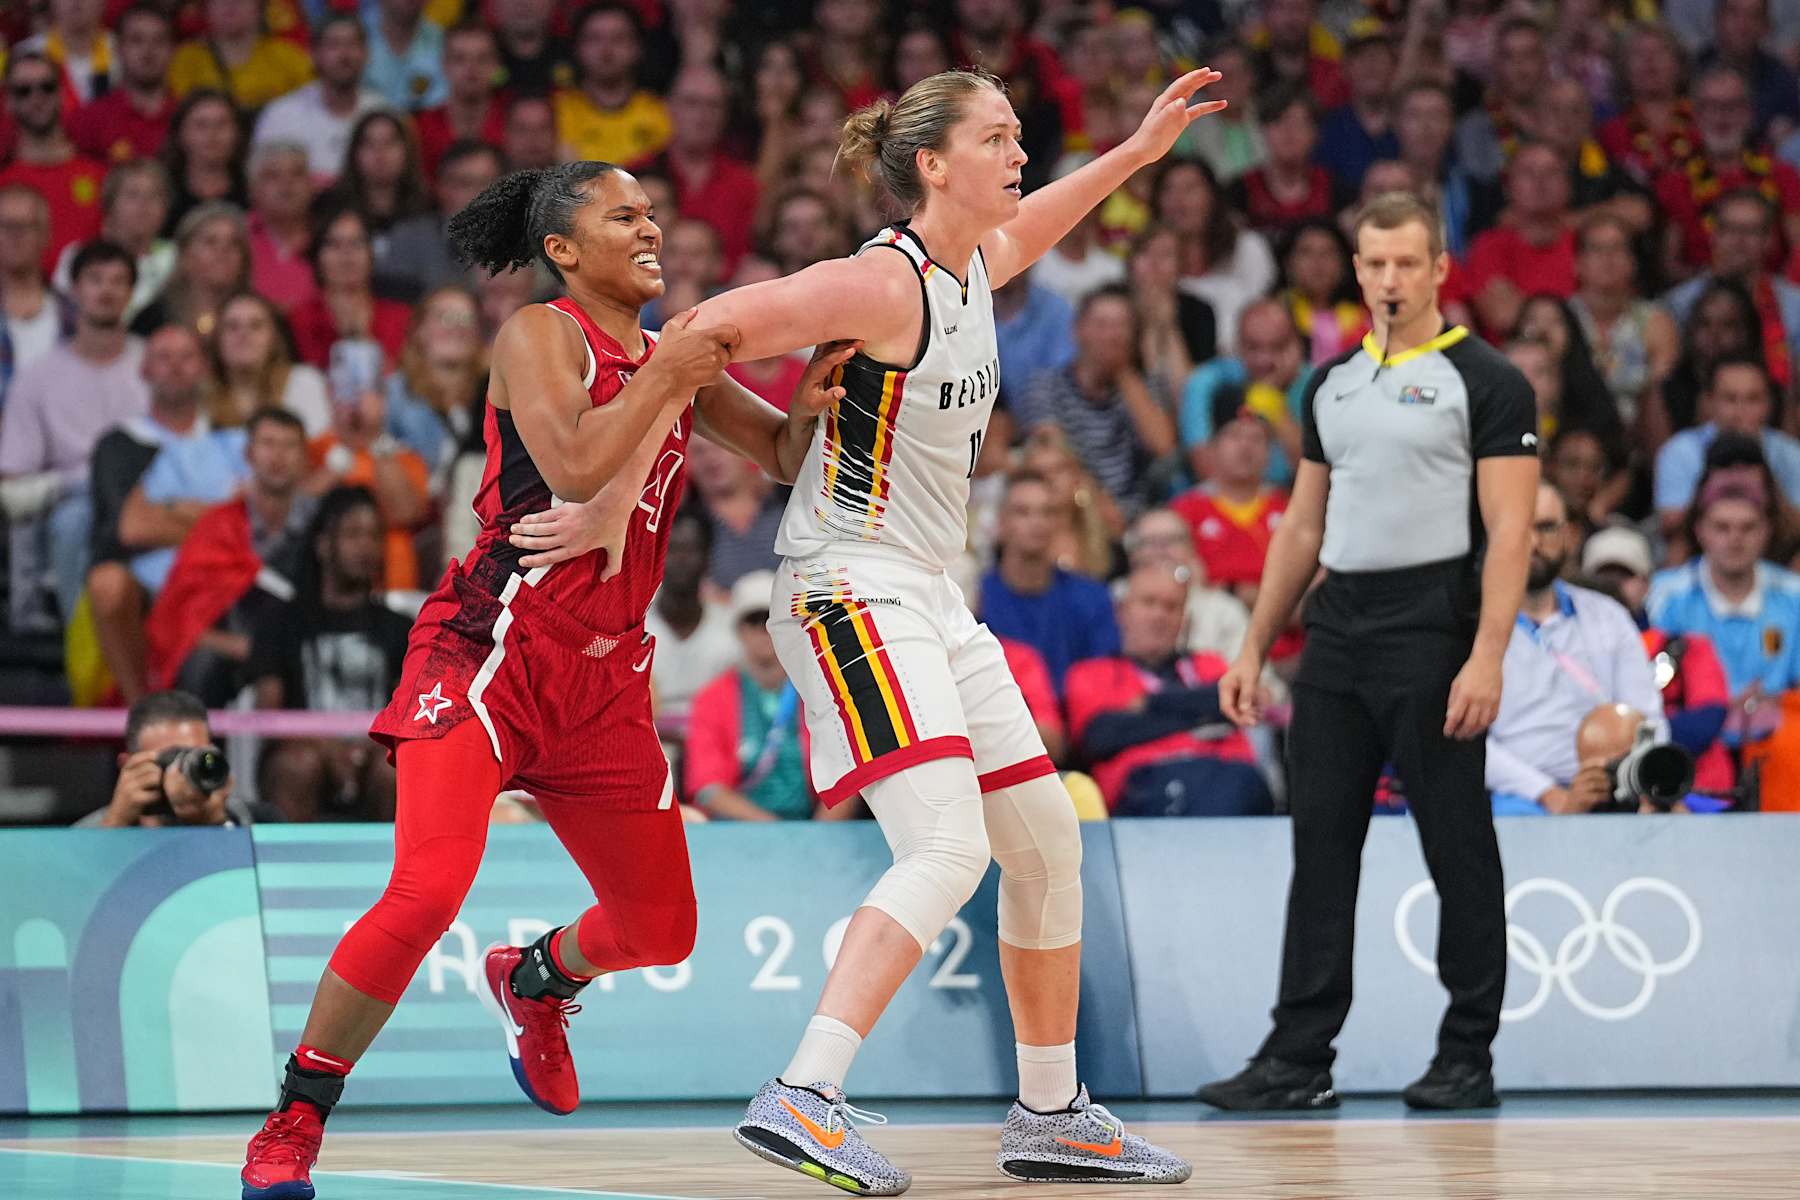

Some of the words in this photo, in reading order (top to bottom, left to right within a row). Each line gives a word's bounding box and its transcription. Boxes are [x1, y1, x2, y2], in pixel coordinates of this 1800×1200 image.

[939, 358, 999, 410] BELGIU
[967, 429, 981, 479] 11
[743, 915, 981, 991] 22
